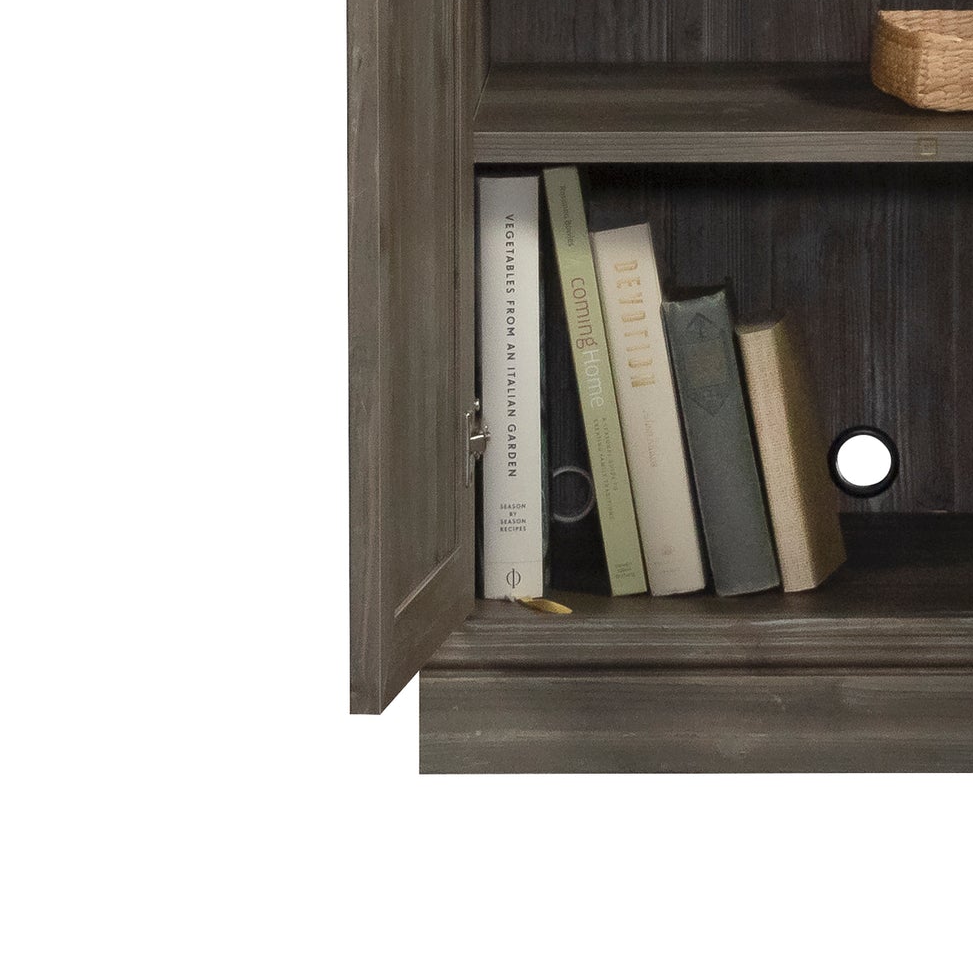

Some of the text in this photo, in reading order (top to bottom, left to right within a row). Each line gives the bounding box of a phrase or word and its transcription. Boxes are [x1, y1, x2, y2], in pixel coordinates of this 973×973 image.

[505, 213, 517, 477] VEGETABLES FROM AN ITALIAN GARDEN
